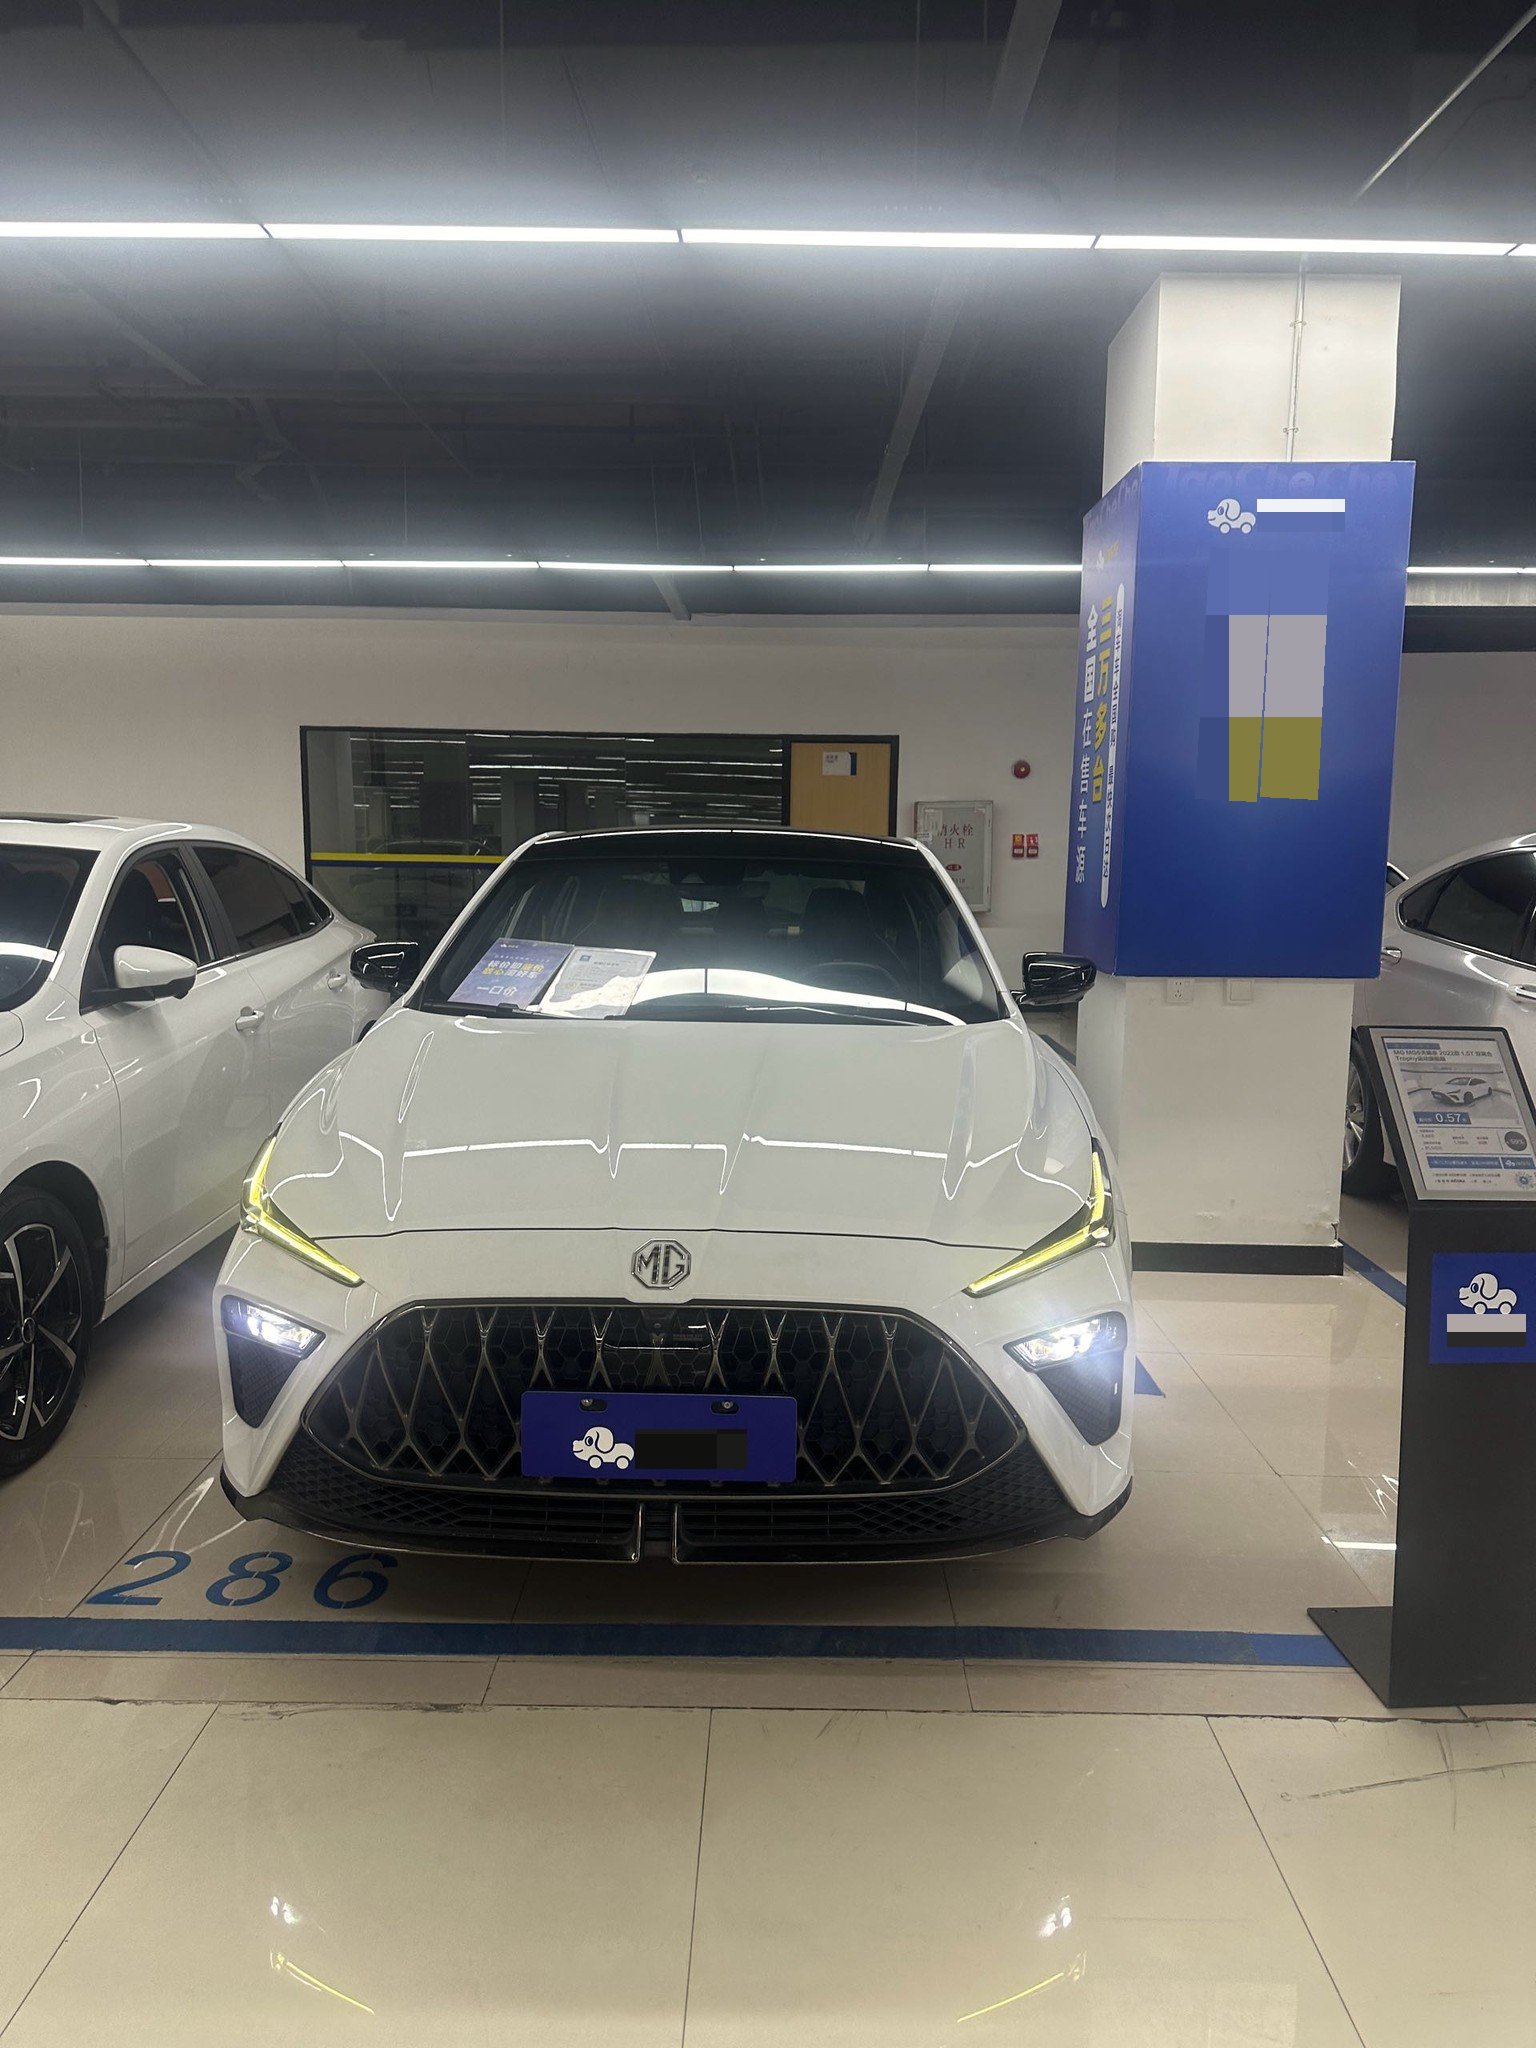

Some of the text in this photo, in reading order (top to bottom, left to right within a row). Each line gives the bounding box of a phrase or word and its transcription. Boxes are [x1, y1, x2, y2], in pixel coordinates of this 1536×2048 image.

[1092, 595, 1113, 802] 三万多台
[1075, 604, 1098, 883] 全国在售车源
[476, 985, 518, 997] 一口价
[1435, 1113, 1461, 1123] 0.57
[636, 1242, 687, 1286] MG
[86, 1550, 398, 1609] 286
